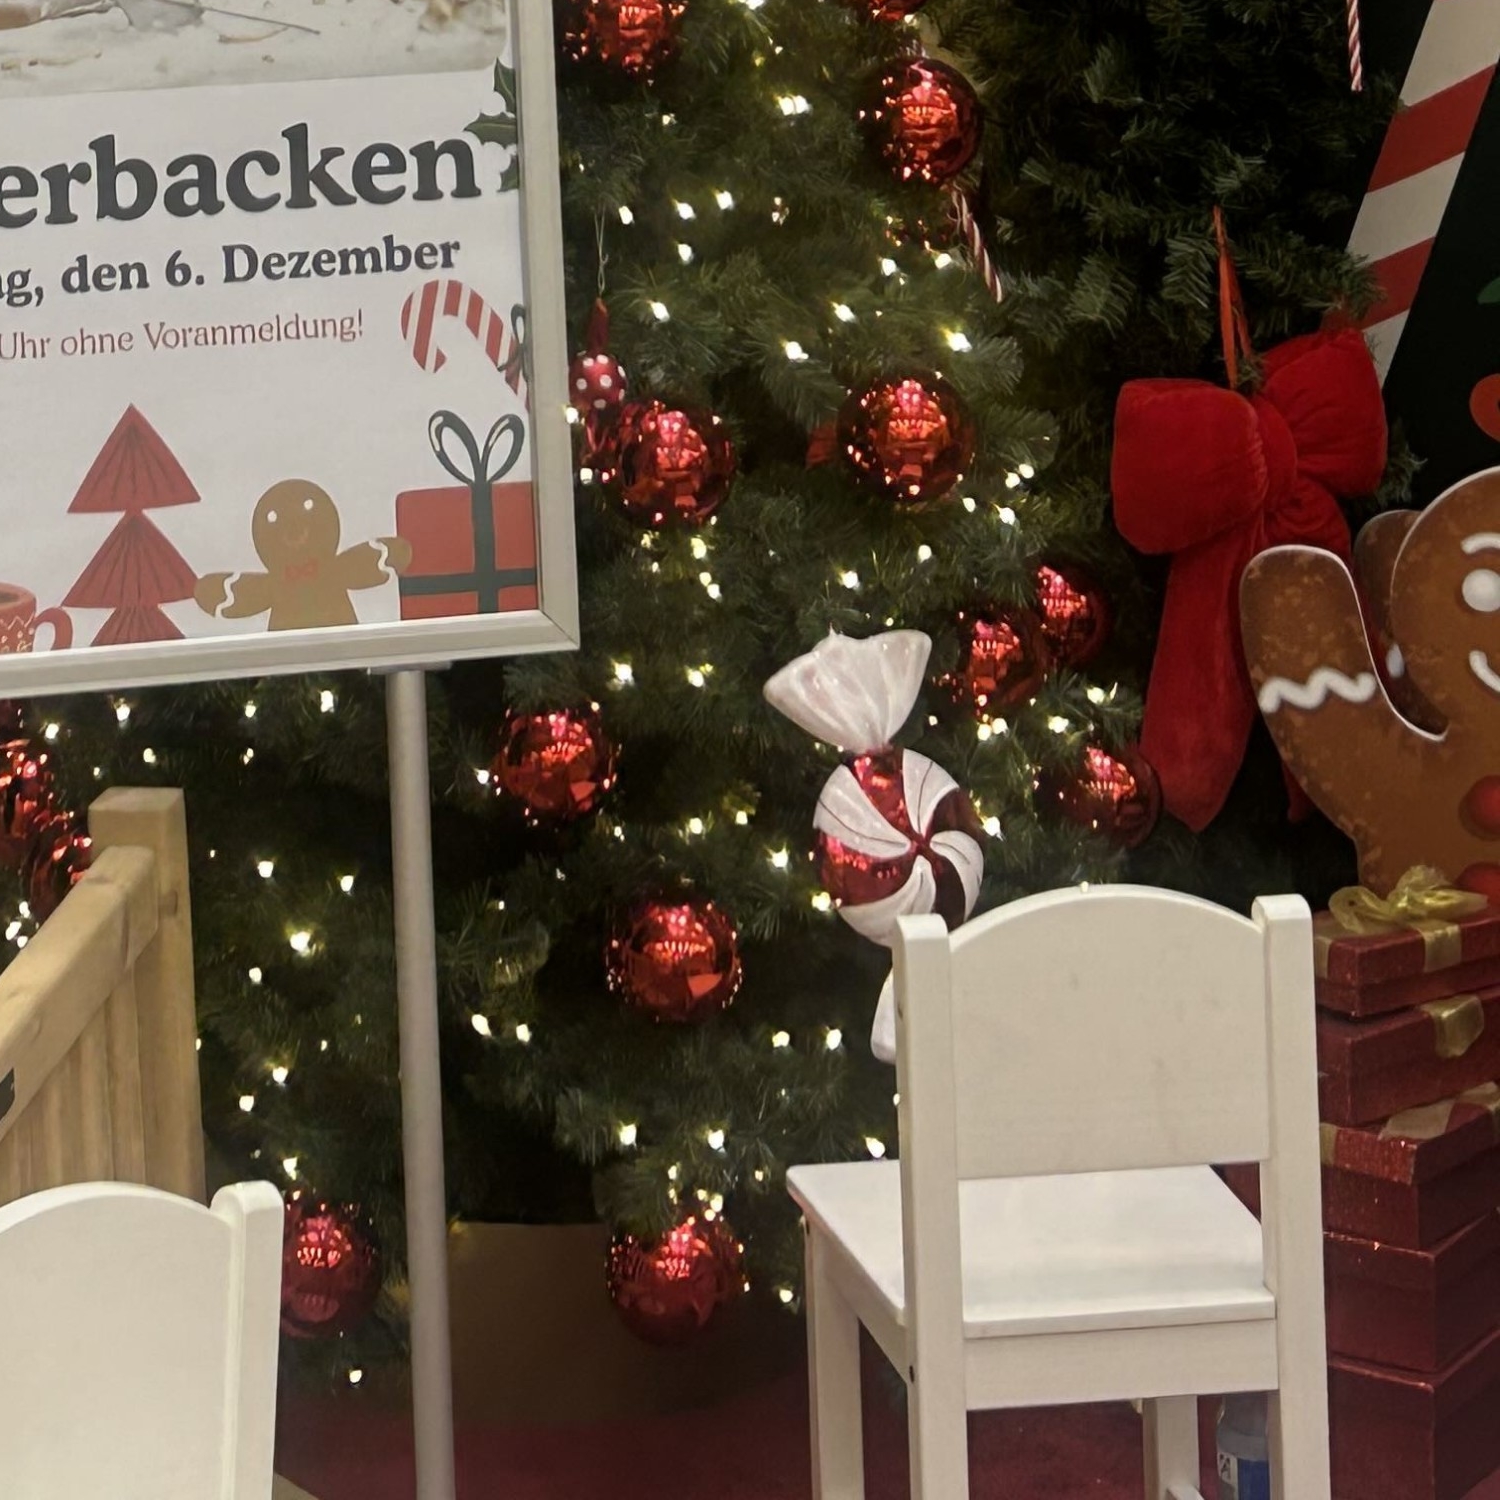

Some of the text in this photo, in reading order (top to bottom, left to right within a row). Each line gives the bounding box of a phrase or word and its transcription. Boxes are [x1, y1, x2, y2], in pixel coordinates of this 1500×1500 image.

[61, 254, 150, 293] den
[164, 249, 205, 288] 6.
[222, 234, 460, 284] Dezember
[61, 327, 134, 357] ohne
[143, 308, 364, 353] Voranmeldung!
